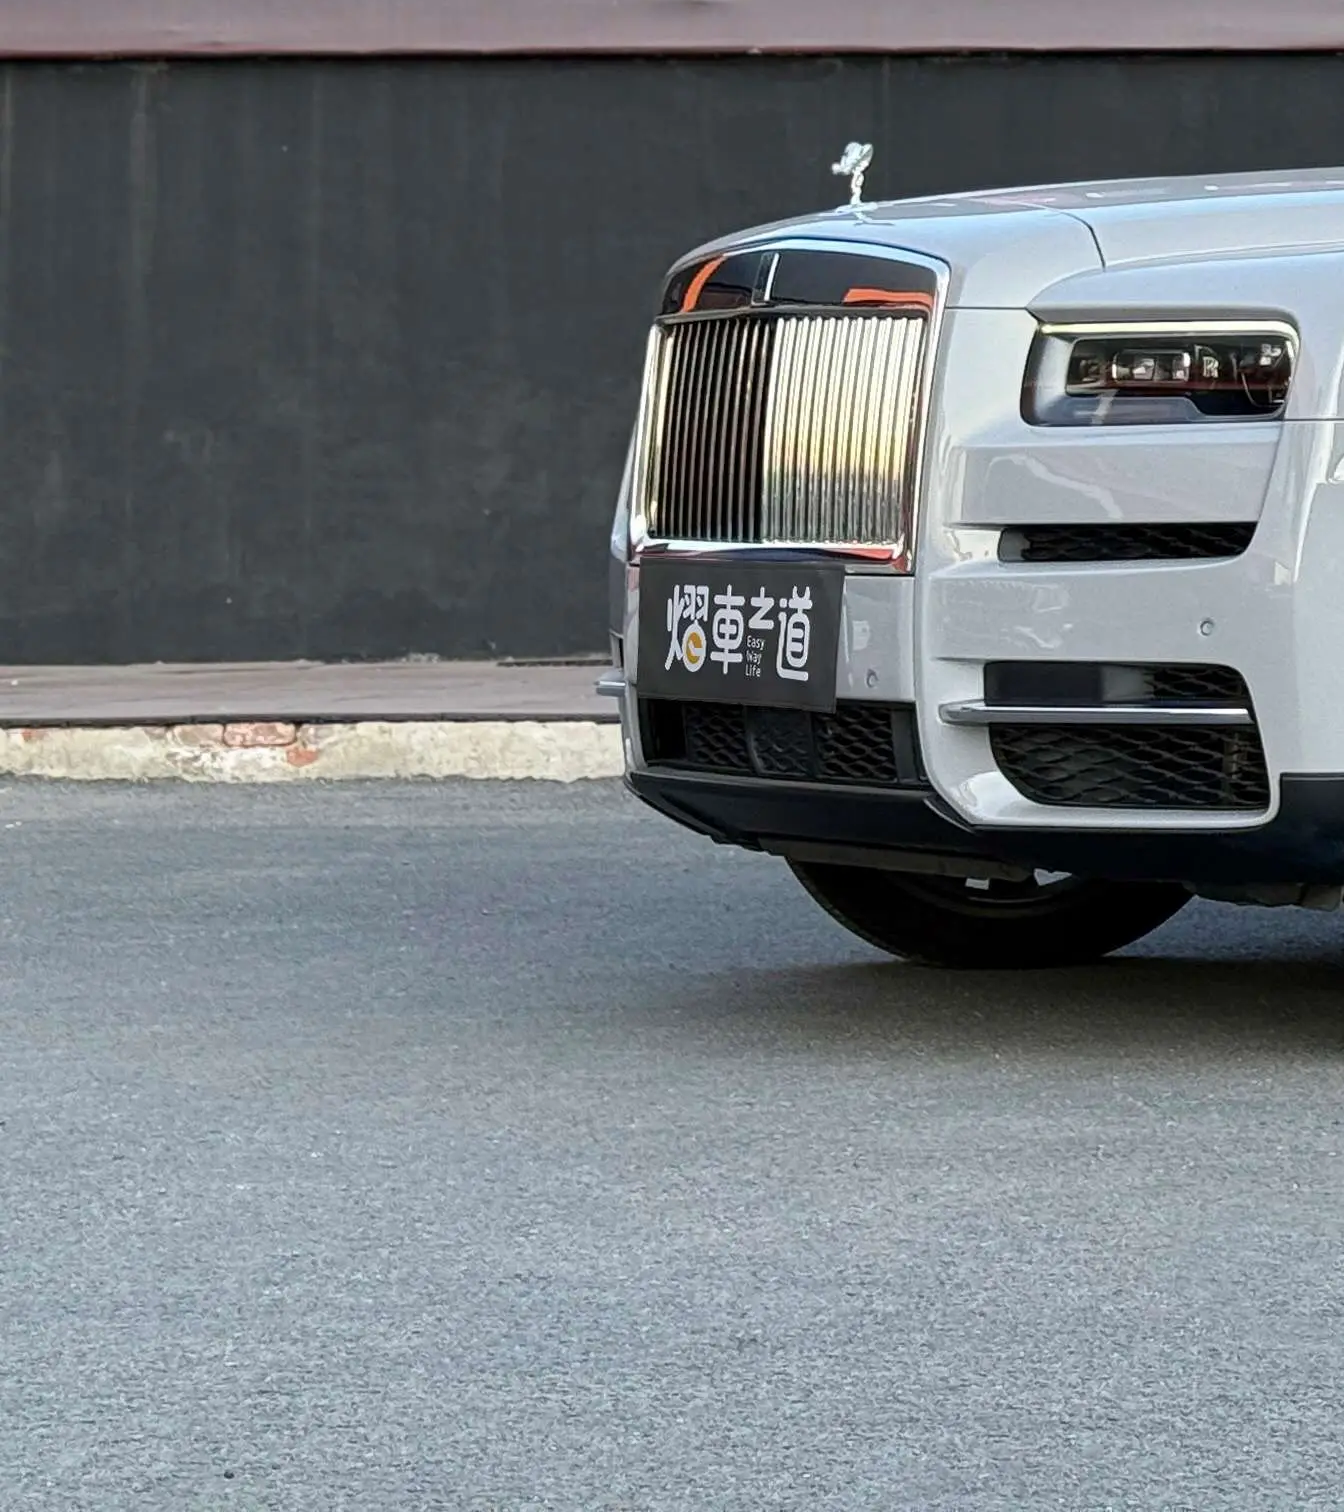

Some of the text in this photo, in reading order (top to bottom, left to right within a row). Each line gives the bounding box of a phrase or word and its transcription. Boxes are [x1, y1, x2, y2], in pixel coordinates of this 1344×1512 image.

[746, 635, 766, 650] Easy
[746, 650, 762, 665] Way
[745, 664, 761, 677] Life
